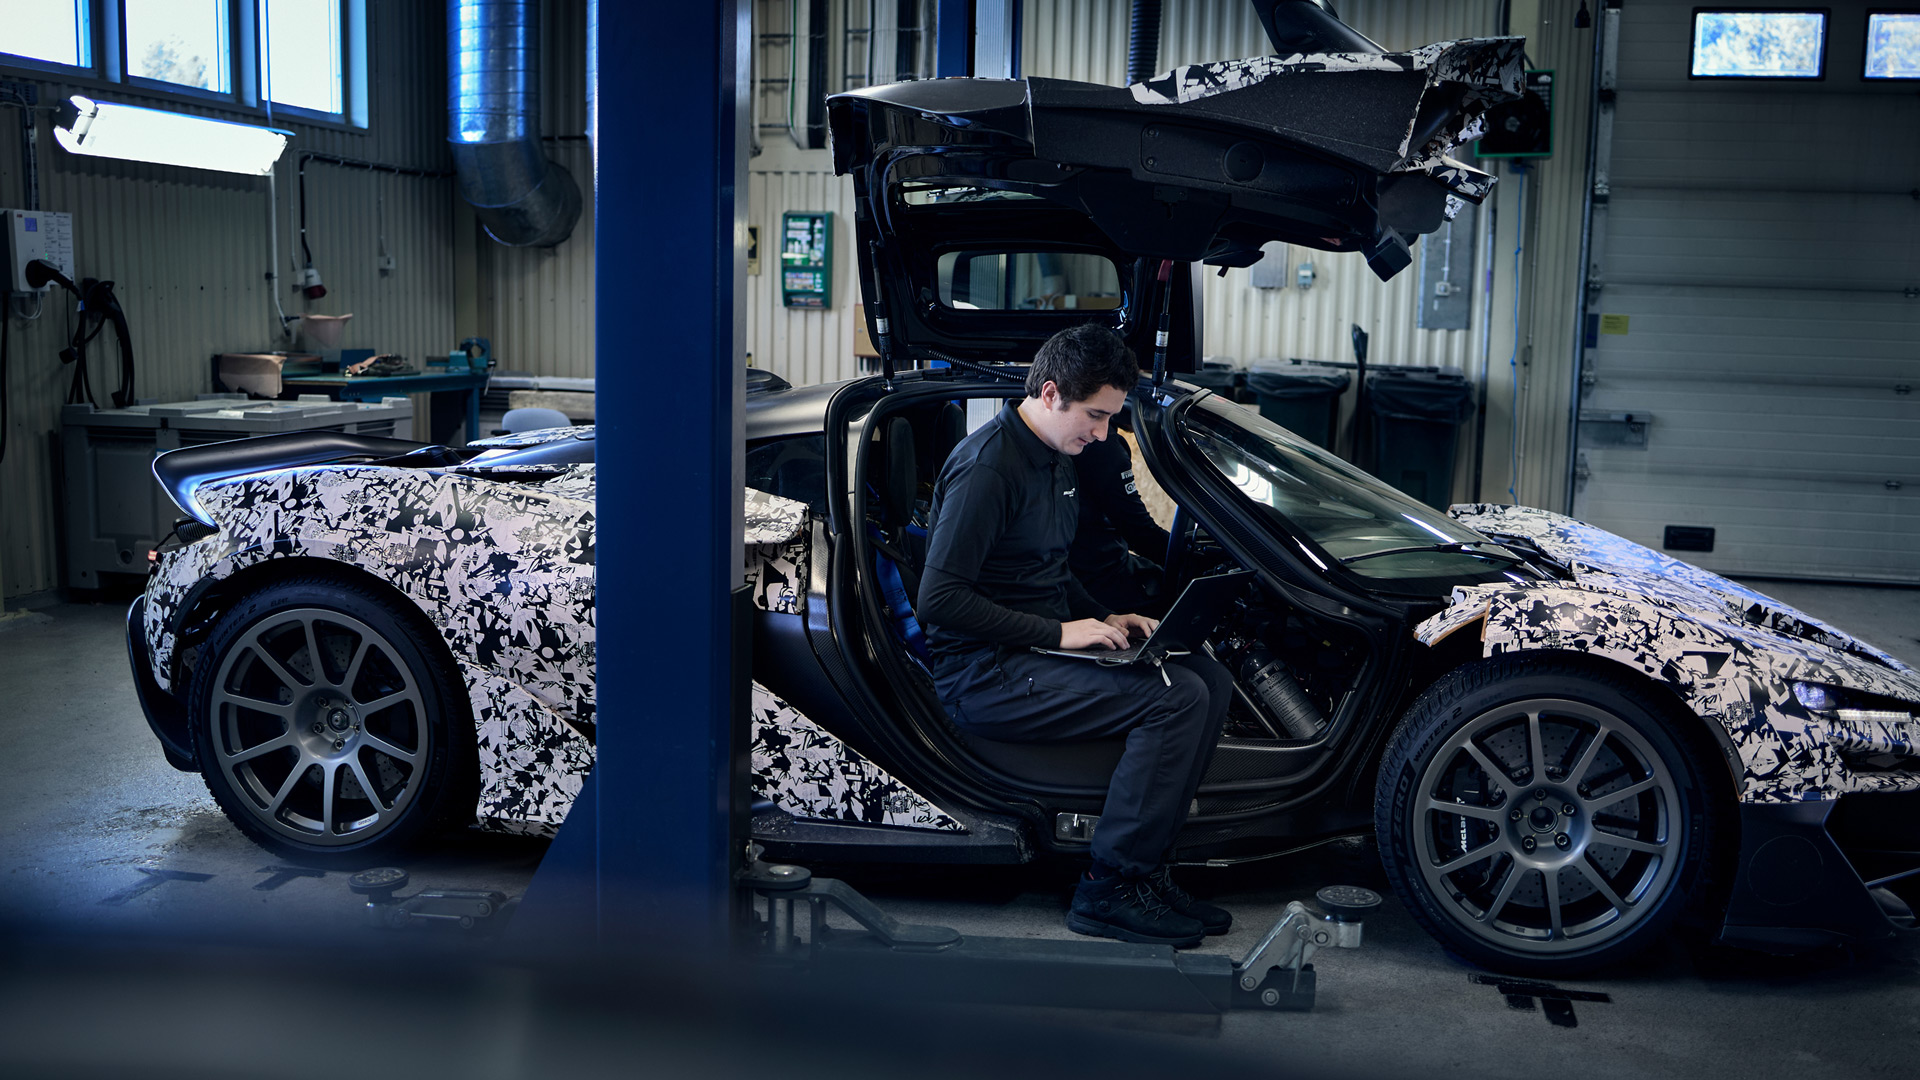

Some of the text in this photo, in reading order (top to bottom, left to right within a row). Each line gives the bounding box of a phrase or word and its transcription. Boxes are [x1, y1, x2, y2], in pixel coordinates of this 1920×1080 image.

[214, 603, 257, 646] WINTER 2
[1413, 706, 1464, 762] WINTER 2
[1393, 775, 1411, 858] P ZERO
[1457, 797, 1467, 853] McLar
